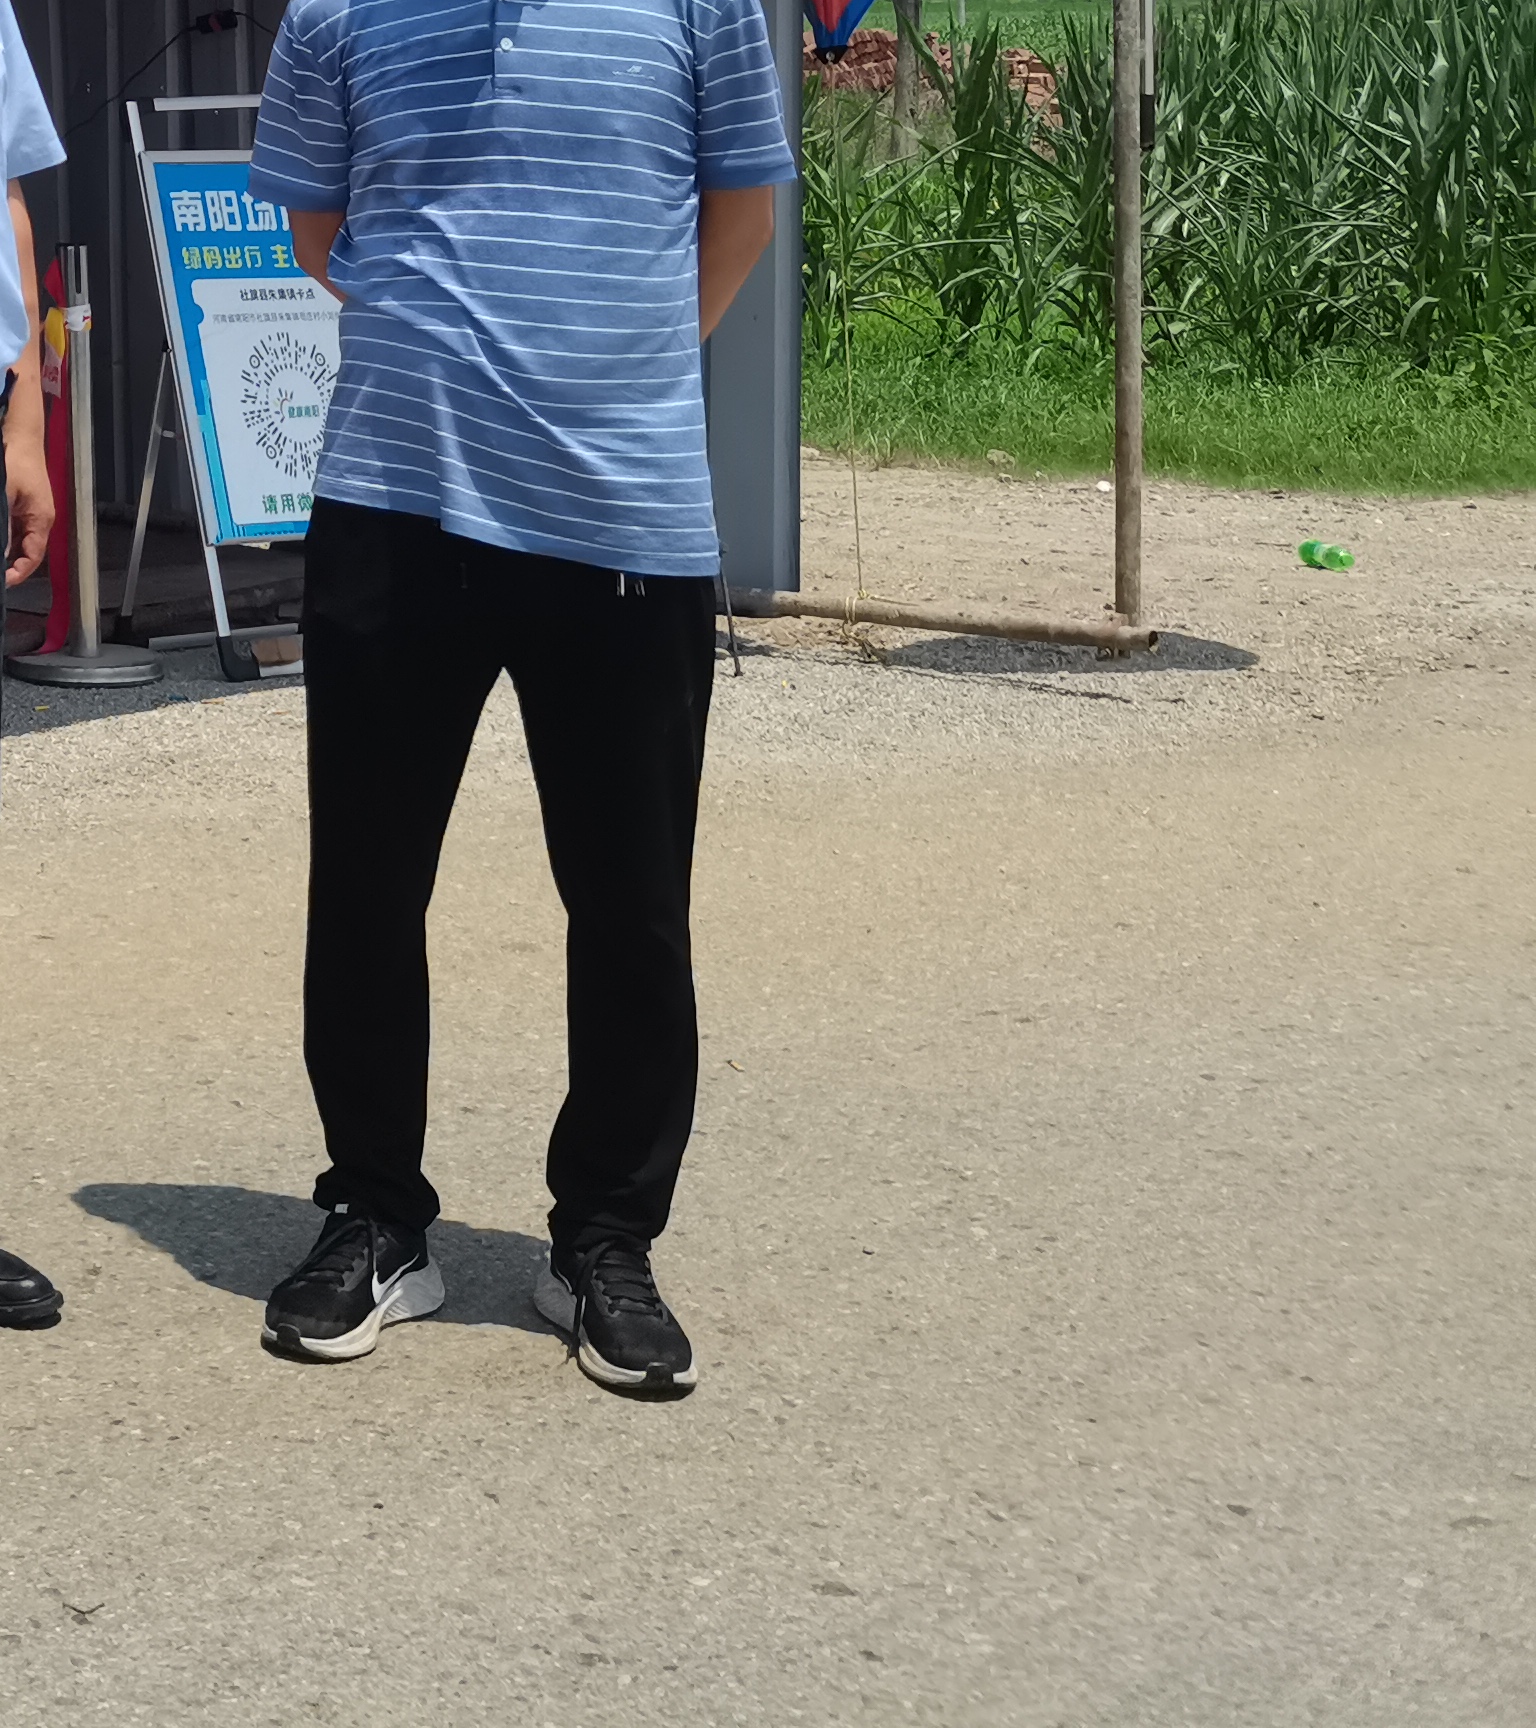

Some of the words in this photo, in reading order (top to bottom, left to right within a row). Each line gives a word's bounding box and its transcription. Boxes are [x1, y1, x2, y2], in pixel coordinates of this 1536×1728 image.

[169, 189, 290, 232] 南阳场
[181, 244, 263, 270] 绿码出行
[270, 243, 300, 269] 主
[239, 287, 316, 302] 社旗县朱集镇卡点
[287, 404, 320, 419] 健康南阳
